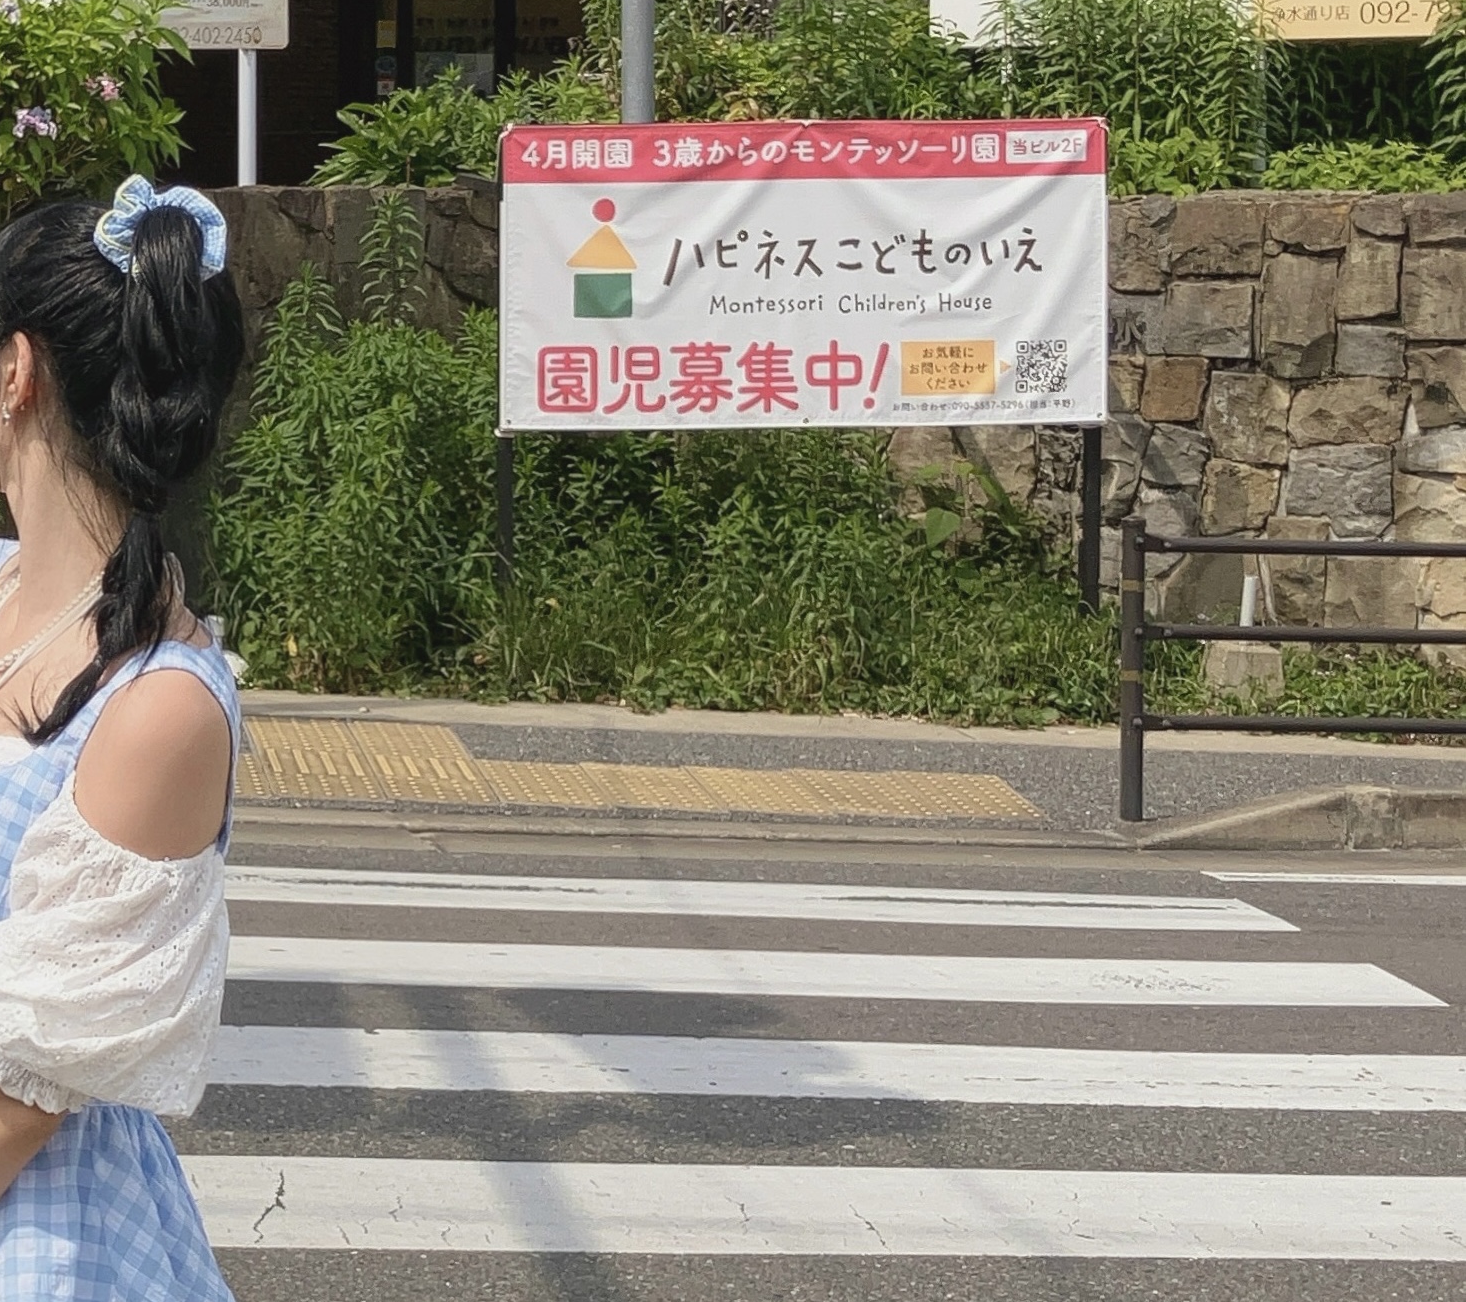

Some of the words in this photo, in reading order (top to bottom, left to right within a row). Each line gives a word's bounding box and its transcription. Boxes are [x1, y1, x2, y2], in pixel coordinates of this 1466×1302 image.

[521, 138, 633, 170] 4月開園
[653, 133, 1000, 168] 3歳からのモンテッソーリ園
[1012, 137, 1083, 156] 当ビル2F
[709, 294, 824, 315] Montessori
[838, 293, 926, 314] Children's
[938, 292, 992, 312] House
[922, 346, 975, 359] お気軽に
[537, 339, 889, 415] 園児募集中!
[909, 362, 988, 375] お問い合わせ
[927, 377, 971, 390] ください
